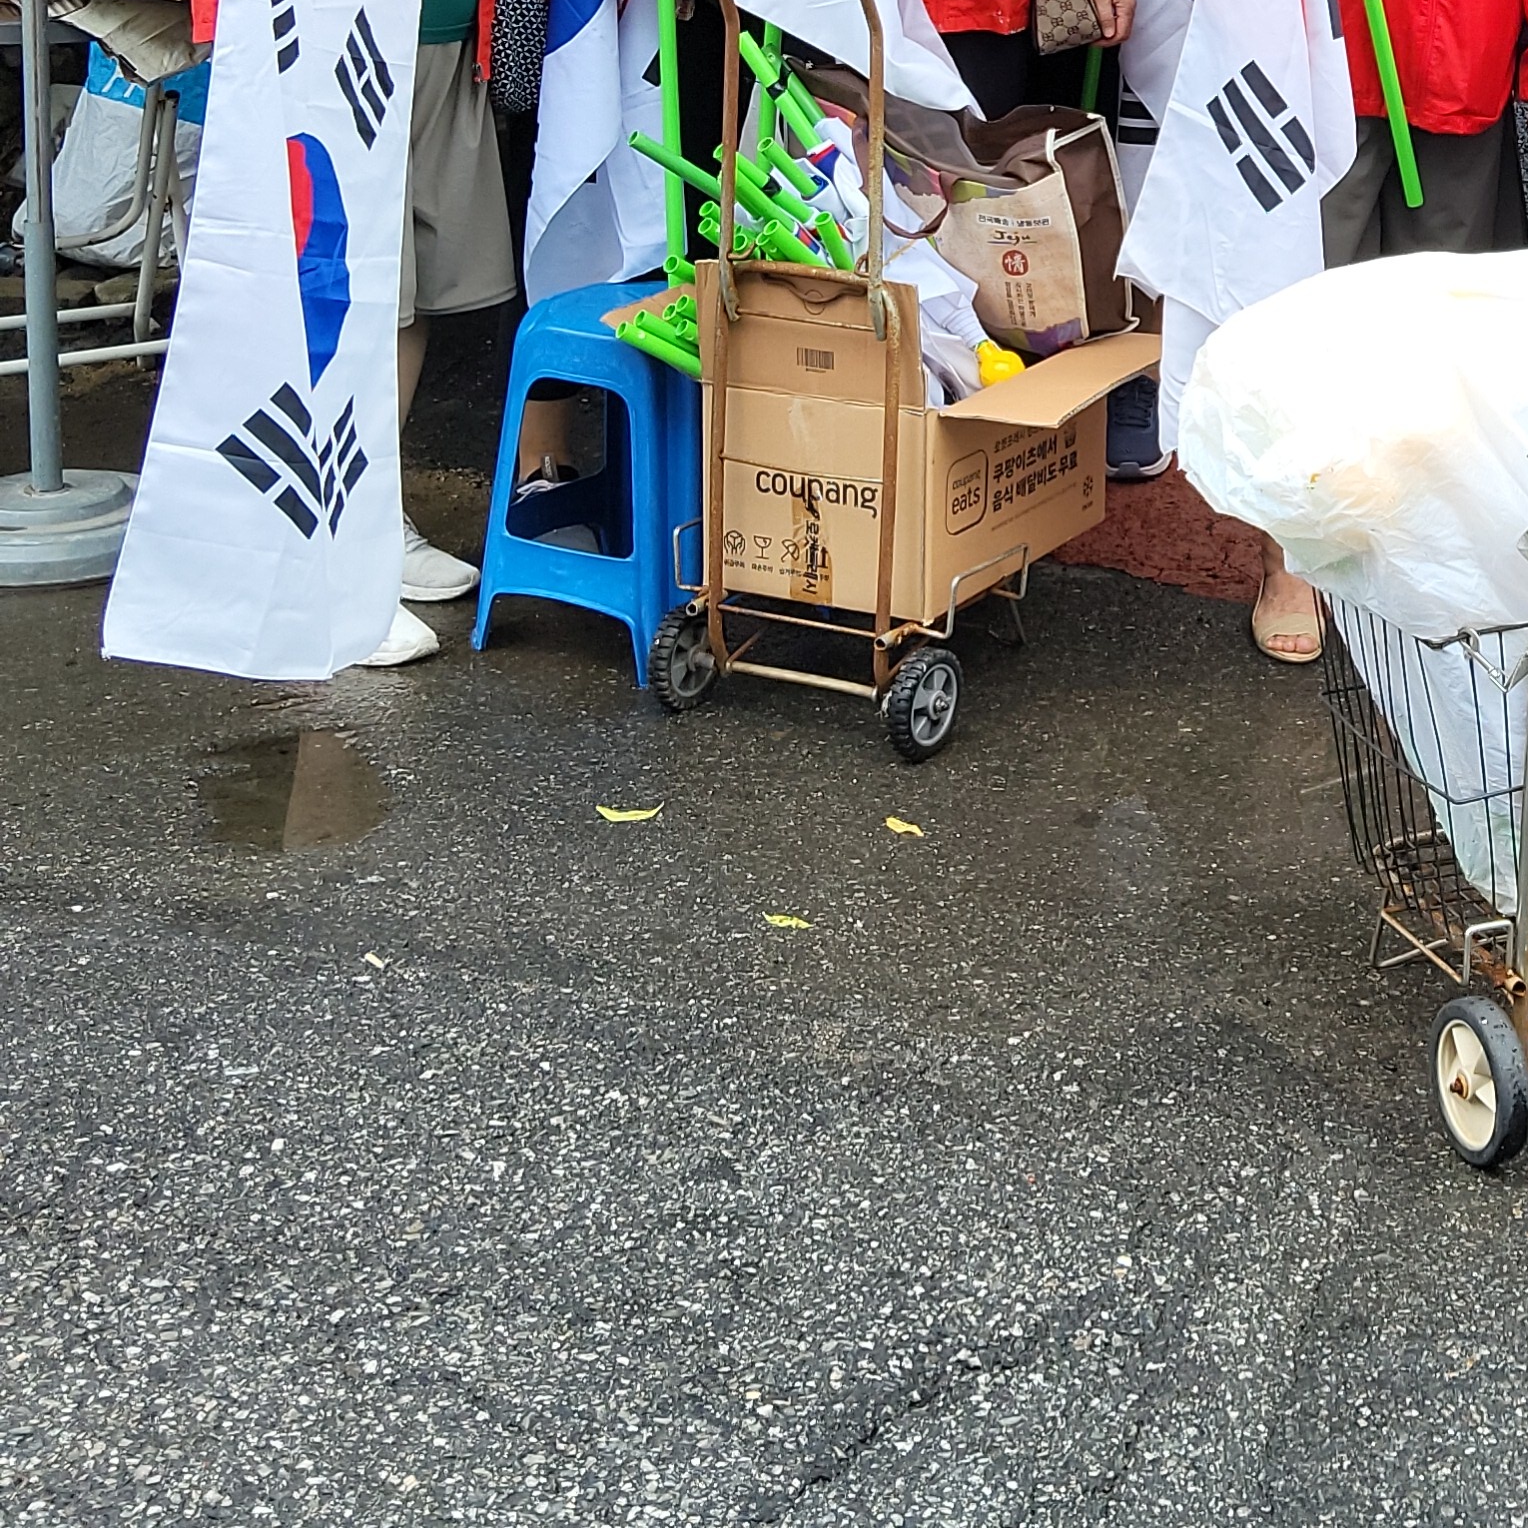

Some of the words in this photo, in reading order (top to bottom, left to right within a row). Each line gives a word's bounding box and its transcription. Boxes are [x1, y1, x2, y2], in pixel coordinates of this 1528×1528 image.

[993, 433, 1058, 484] 쿠팡이츠에서
[755, 470, 879, 520] coupang
[951, 485, 981, 516] eats
[992, 482, 1014, 513] 음식
[1015, 461, 1058, 498] 배달비도
